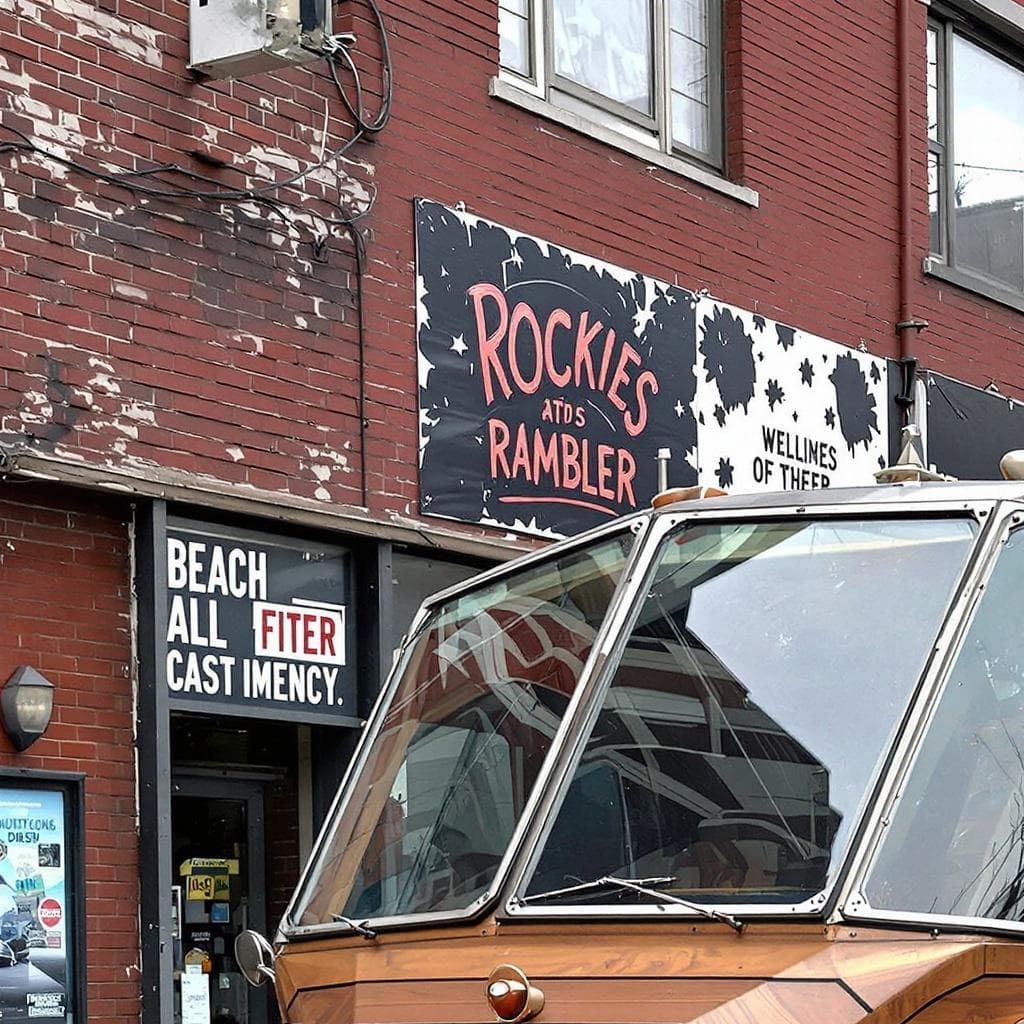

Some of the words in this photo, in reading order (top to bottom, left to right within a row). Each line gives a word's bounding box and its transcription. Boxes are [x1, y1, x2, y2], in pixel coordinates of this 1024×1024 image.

[466, 282, 660, 437] ROCKIES
[487, 418, 637, 508] RAMBLER
[753, 456, 774, 485] OF
[761, 424, 838, 471] WELLINES
[167, 538, 267, 600] BEACH
[167, 595, 227, 649] ALL
[261, 609, 337, 657] FITER
[166, 649, 236, 696] CAST
[242, 659, 344, 706] IMENCY.
